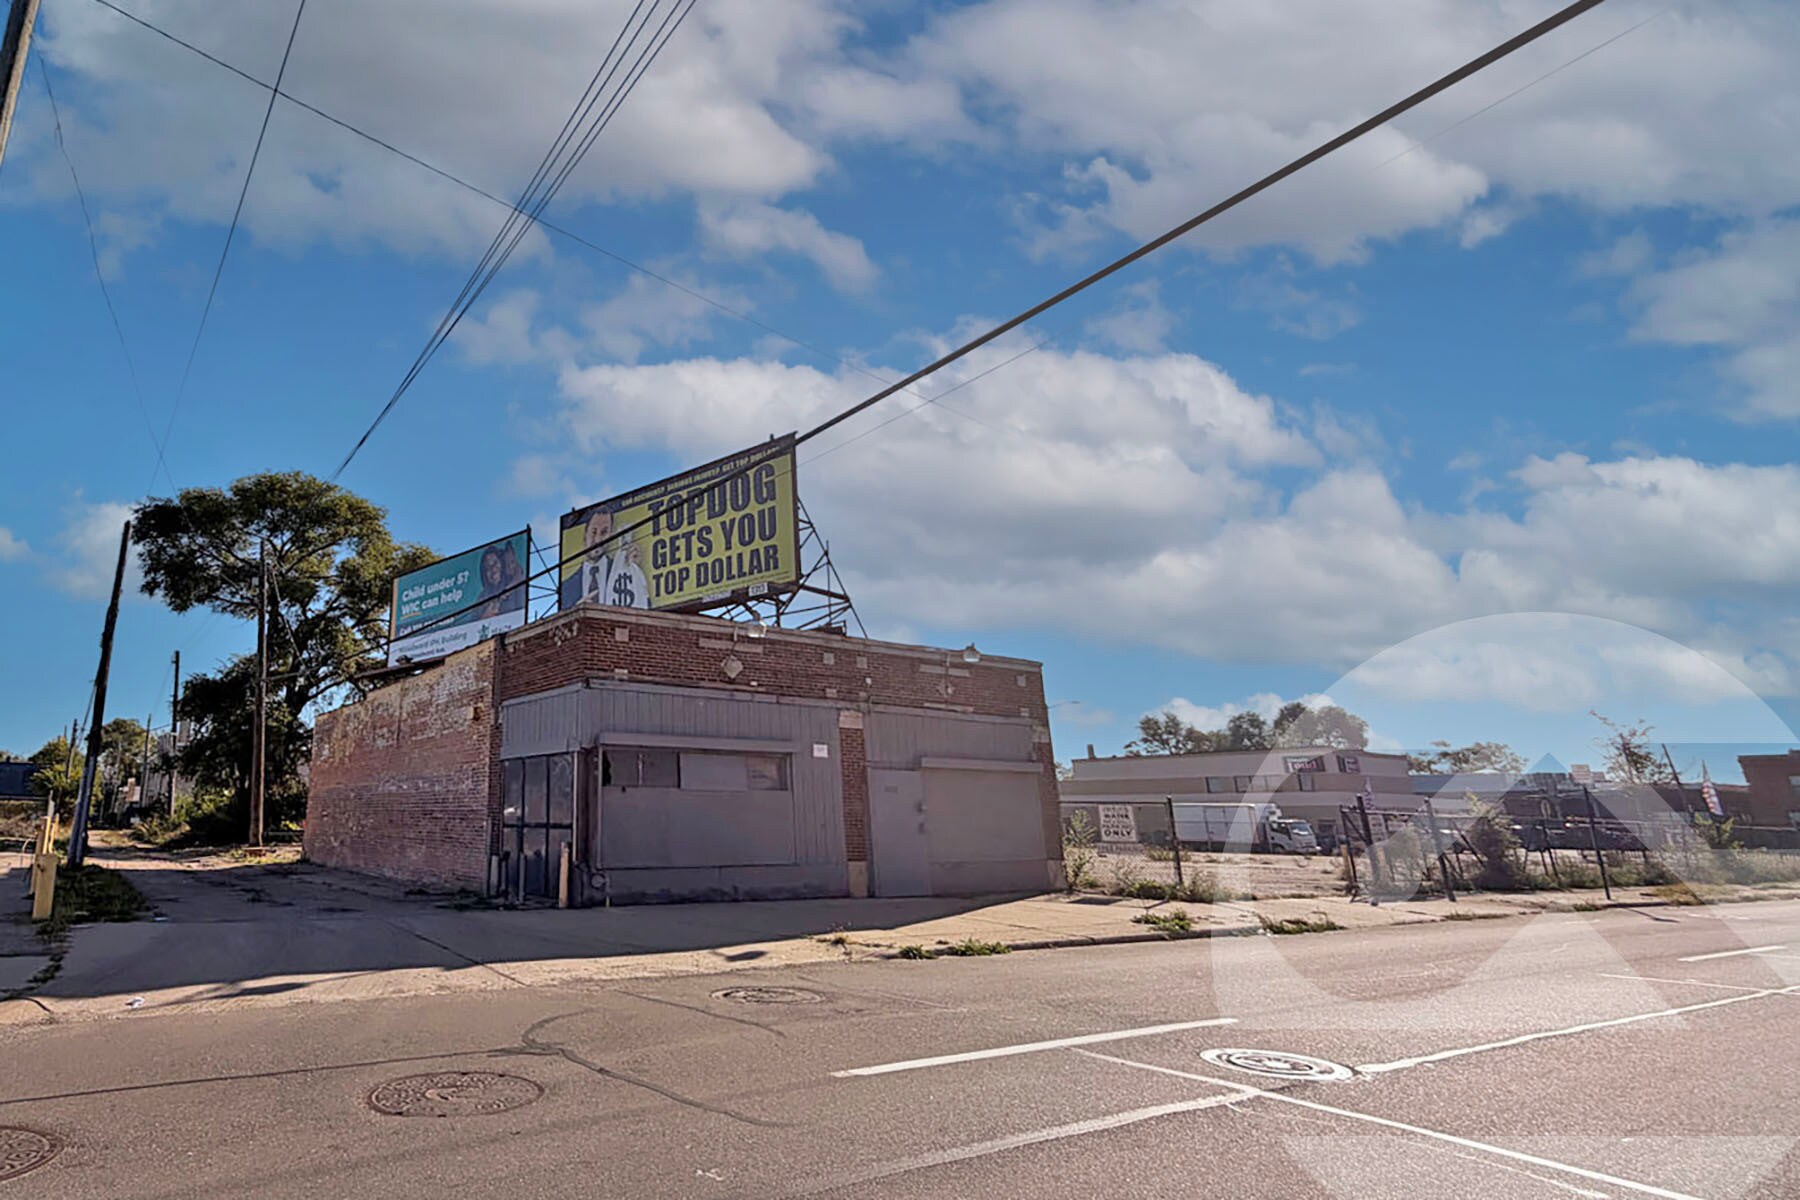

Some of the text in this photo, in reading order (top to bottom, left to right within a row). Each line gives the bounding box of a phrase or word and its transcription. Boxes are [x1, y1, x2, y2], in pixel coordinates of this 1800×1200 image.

[648, 462, 777, 537] TOPDOG
[652, 505, 777, 571] GETS YOU
[402, 569, 470, 602] Child under 5?
[652, 544, 779, 598] TOP DOLLAR
[401, 588, 463, 616] WIC can help
[1104, 829, 1132, 837] ONLY
